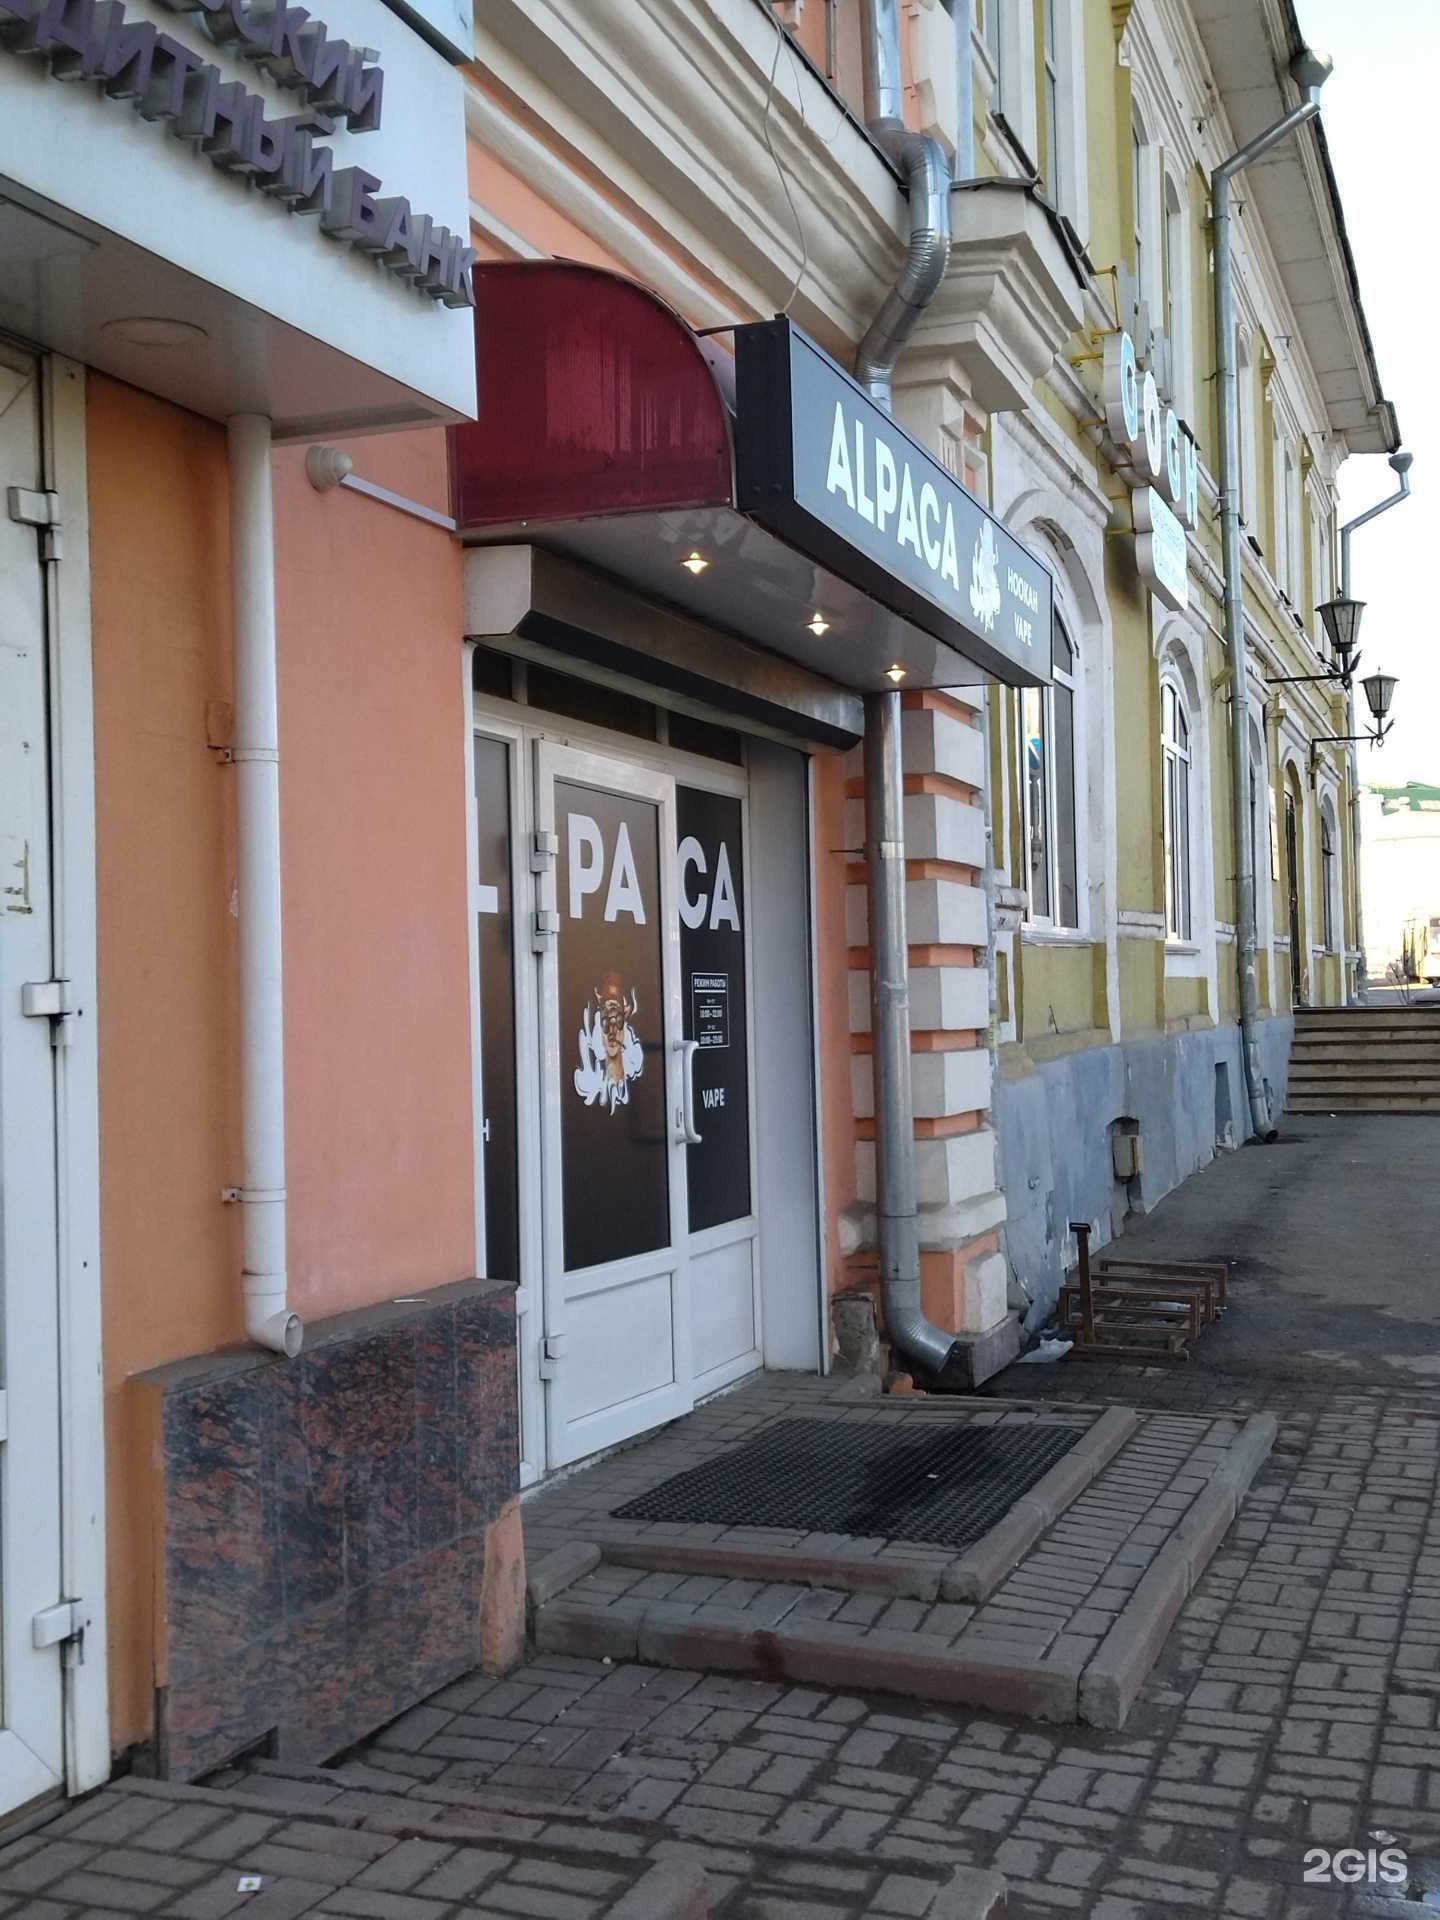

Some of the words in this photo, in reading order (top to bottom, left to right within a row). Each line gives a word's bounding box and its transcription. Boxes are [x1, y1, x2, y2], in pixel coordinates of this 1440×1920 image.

[158, 0, 384, 134] СКИЙ
[0, 0, 334, 214] ДИТНЫЙ
[321, 165, 478, 309] БАНК
[826, 400, 960, 592] ALPACA
[1007, 565, 1039, 615] HOOKAH
[1013, 611, 1033, 647] VAPE
[702, 1087, 726, 1109] VAPE
